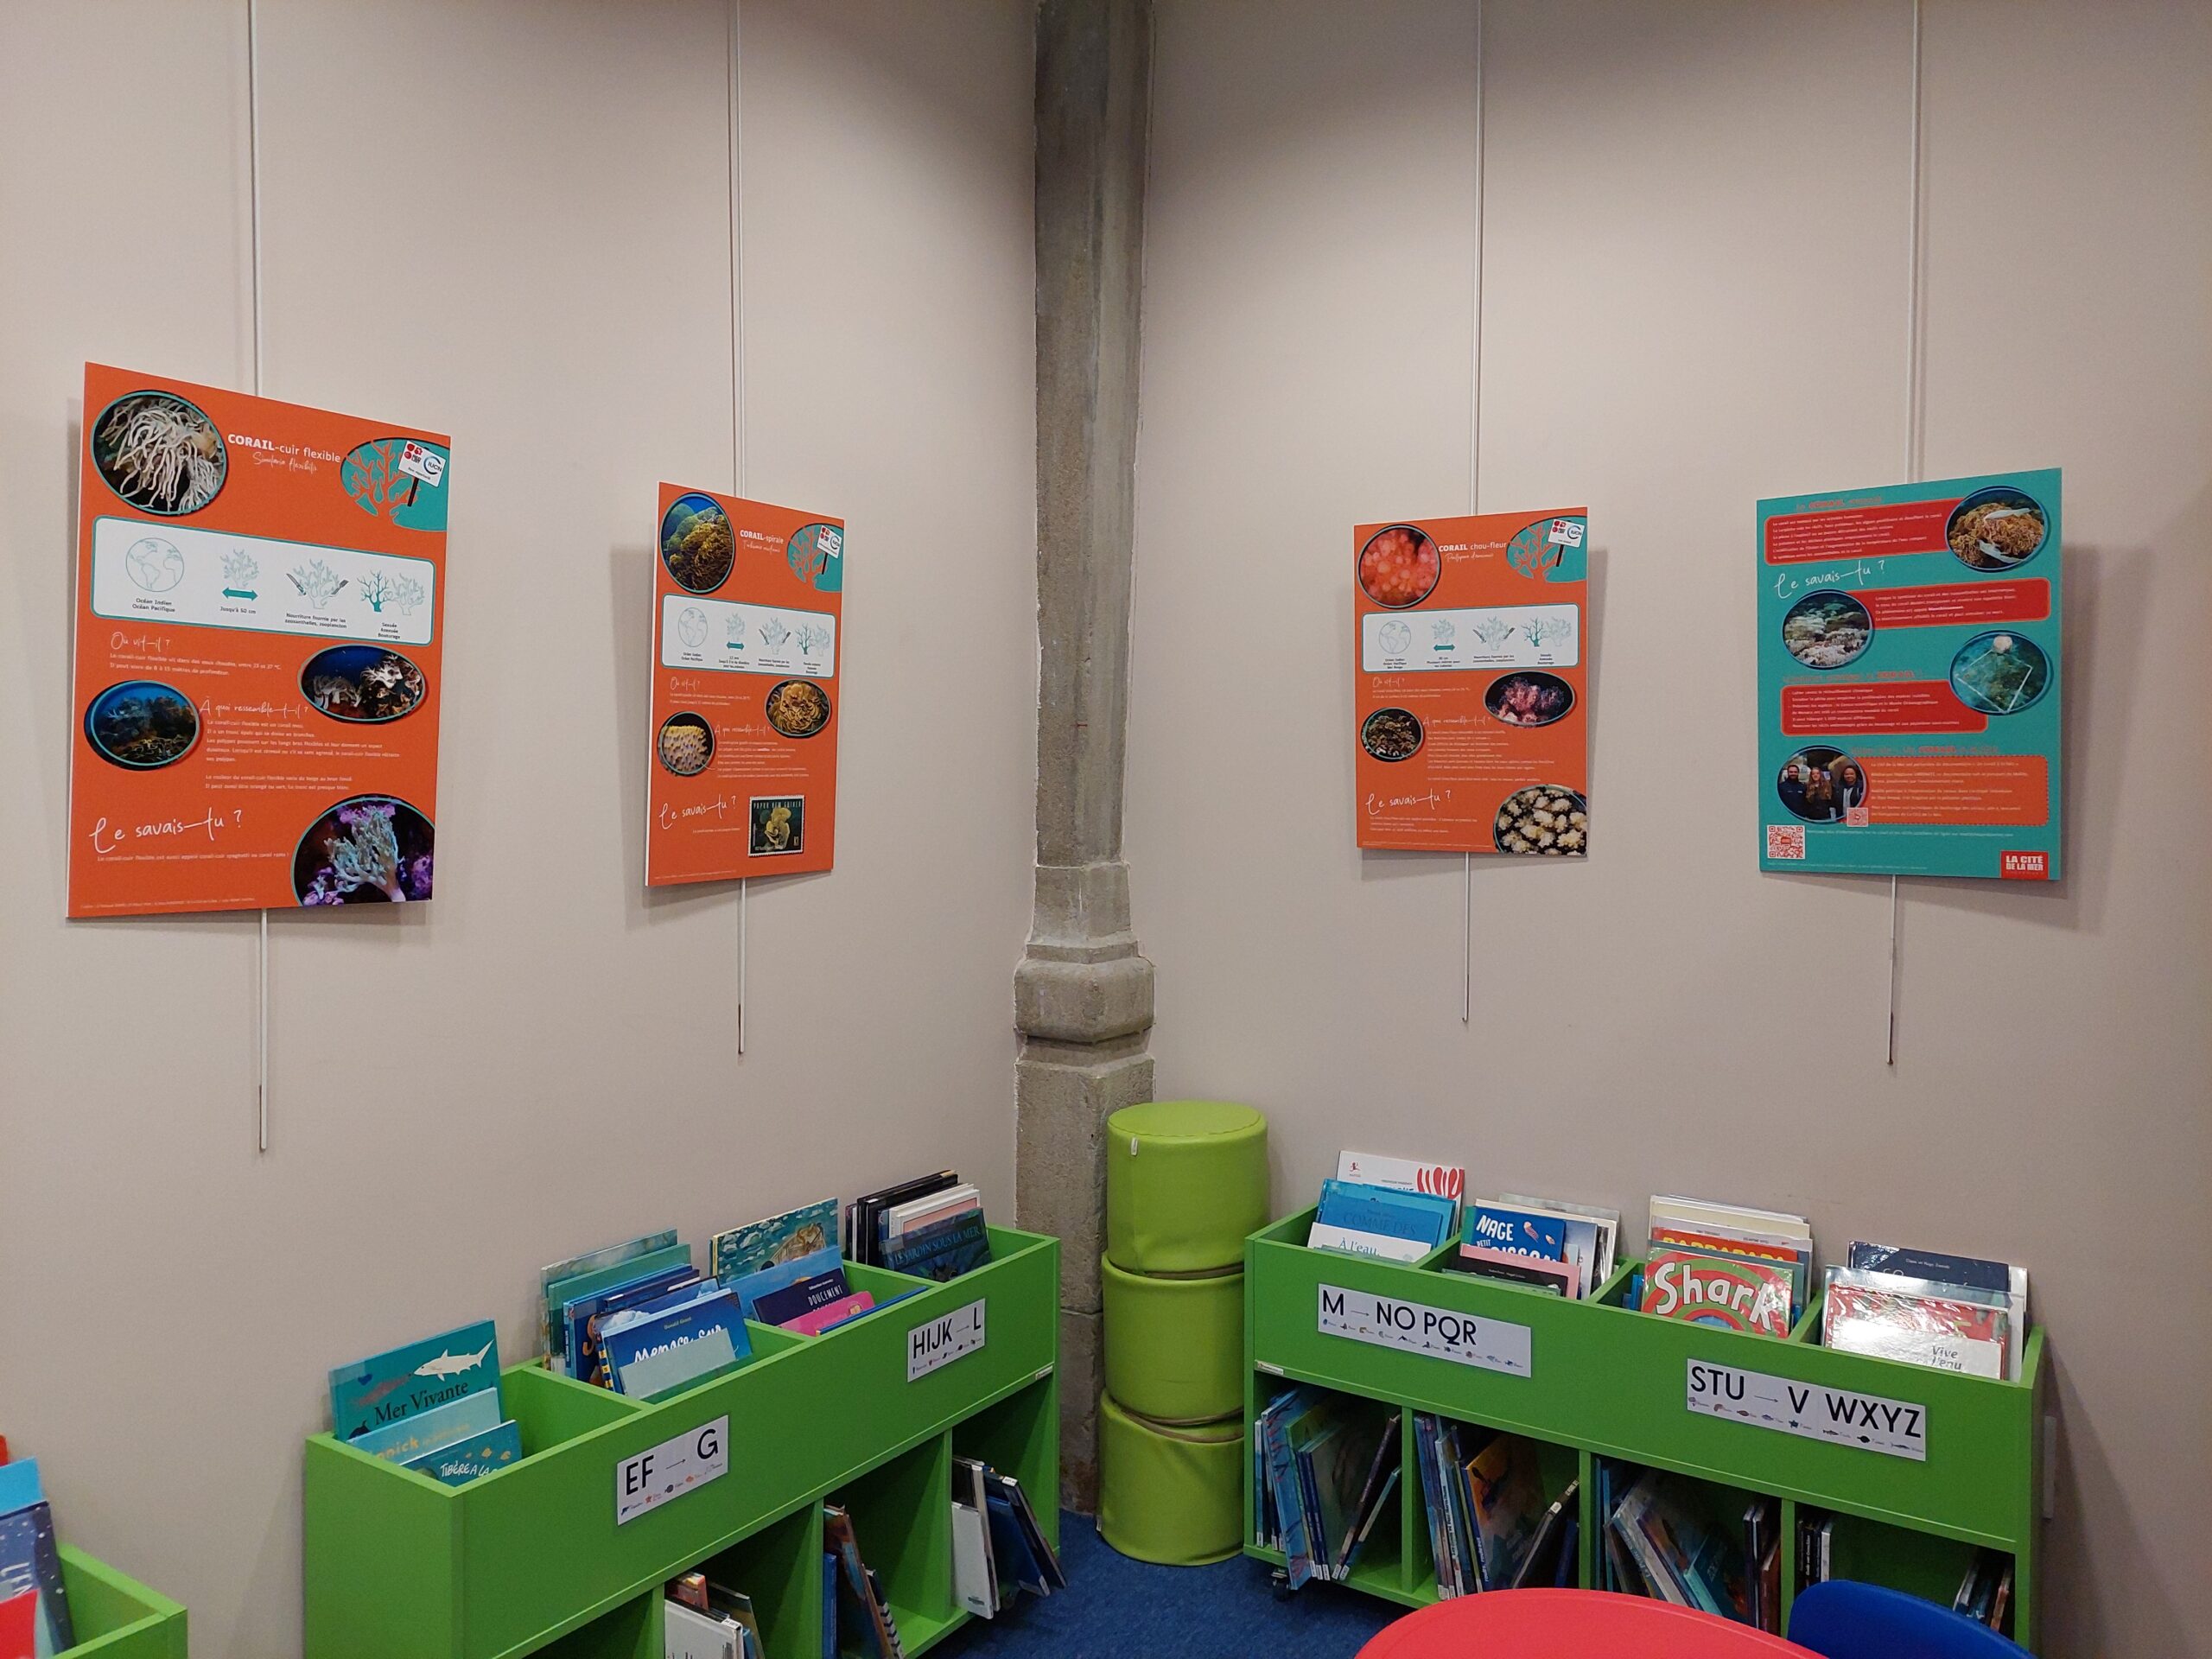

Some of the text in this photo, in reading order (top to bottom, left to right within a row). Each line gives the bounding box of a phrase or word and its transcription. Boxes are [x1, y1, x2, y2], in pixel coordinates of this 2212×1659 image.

[228, 434, 340, 463] CORAIL-cuir flexible
[428, 461, 442, 472] IUCN
[1439, 541, 1508, 552] CORAIL chou-fleur
[1805, 559, 1872, 586] savais-tu
[682, 794, 728, 820] savais-tu
[1389, 788, 1441, 810] savais-tu
[136, 806, 225, 842] savais-tu
[232, 809, 243, 829] ?
[2005, 855, 2018, 863] LA
[1343, 1211, 1417, 1236] COMME DES
[1475, 1214, 1515, 1242] NAGE
[933, 1236, 951, 1251] SOUS
[952, 1231, 963, 1243] LA
[963, 1225, 981, 1239] MER
[1338, 1236, 1350, 1250] À
[1476, 1238, 1492, 1248] PETIT
[808, 1284, 843, 1306] DOUCEMENT
[1654, 1262, 1774, 1332] Shark
[1323, 1289, 1344, 1316] M
[1424, 1311, 1477, 1346] PQR
[913, 1306, 982, 1359] HIJK L
[1932, 1344, 1959, 1359] Vive
[1932, 1357, 1962, 1371] l'eau
[374, 1382, 468, 1426] Mer Vivante
[1690, 1365, 1745, 1401] STU
[1787, 1386, 1810, 1414] V
[1825, 1393, 1922, 1439] WXYZ
[440, 1459, 470, 1478] TIBÈRE
[469, 1464, 478, 1476] A
[626, 1454, 654, 1496] EF
[697, 1428, 719, 1459] G
